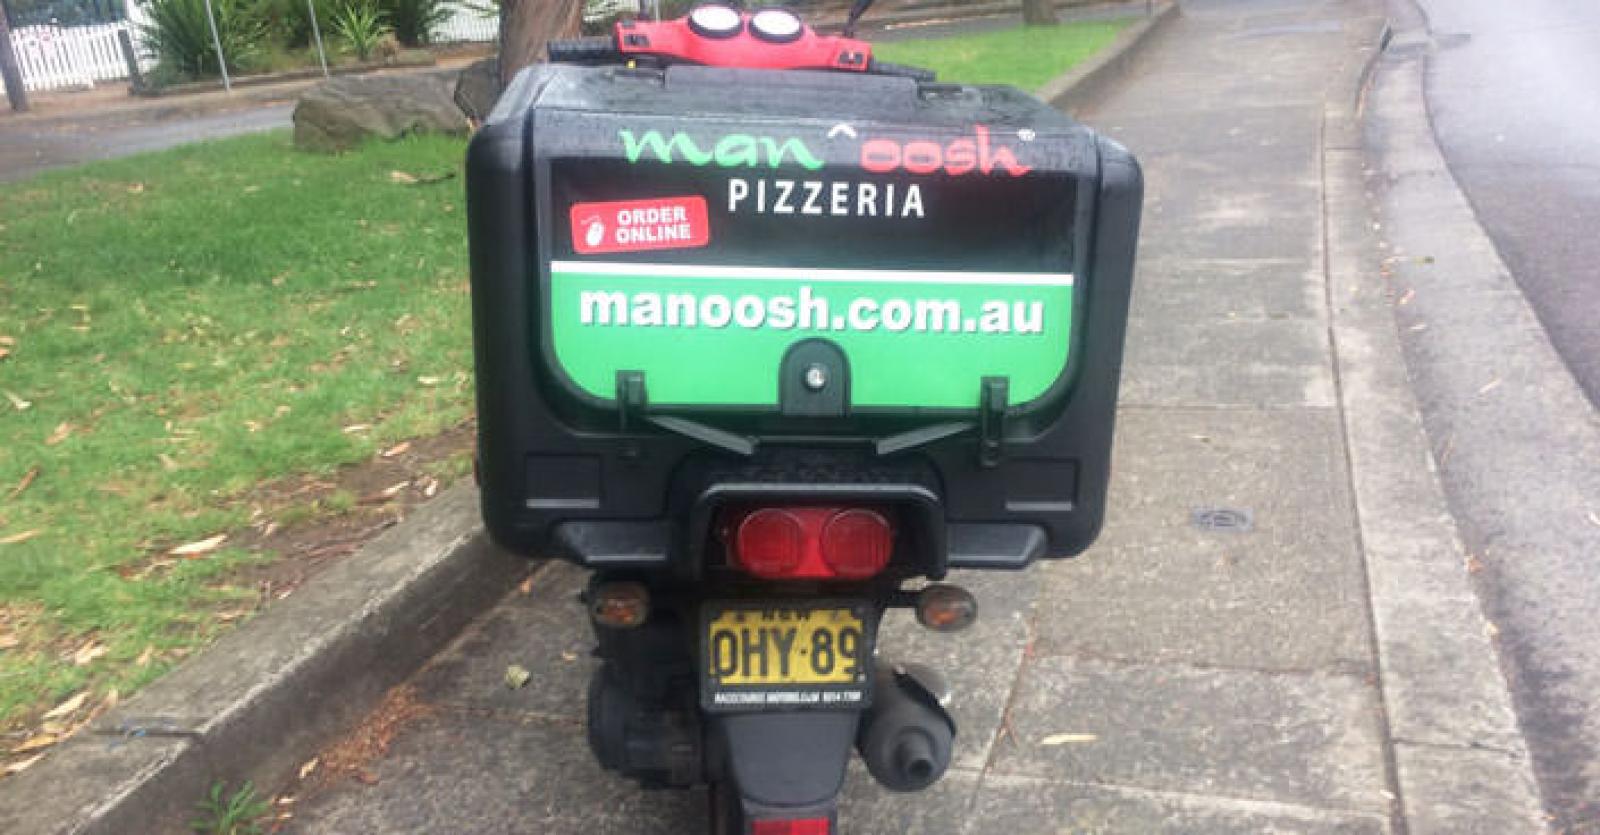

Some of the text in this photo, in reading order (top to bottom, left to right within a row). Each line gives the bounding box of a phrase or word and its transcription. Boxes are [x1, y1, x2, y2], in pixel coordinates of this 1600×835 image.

[728, 178, 925, 218] PIZZERIA
[617, 206, 687, 226] ORDER
[616, 224, 691, 244] ONLINE
[580, 286, 1045, 333] manoosh.com.au
